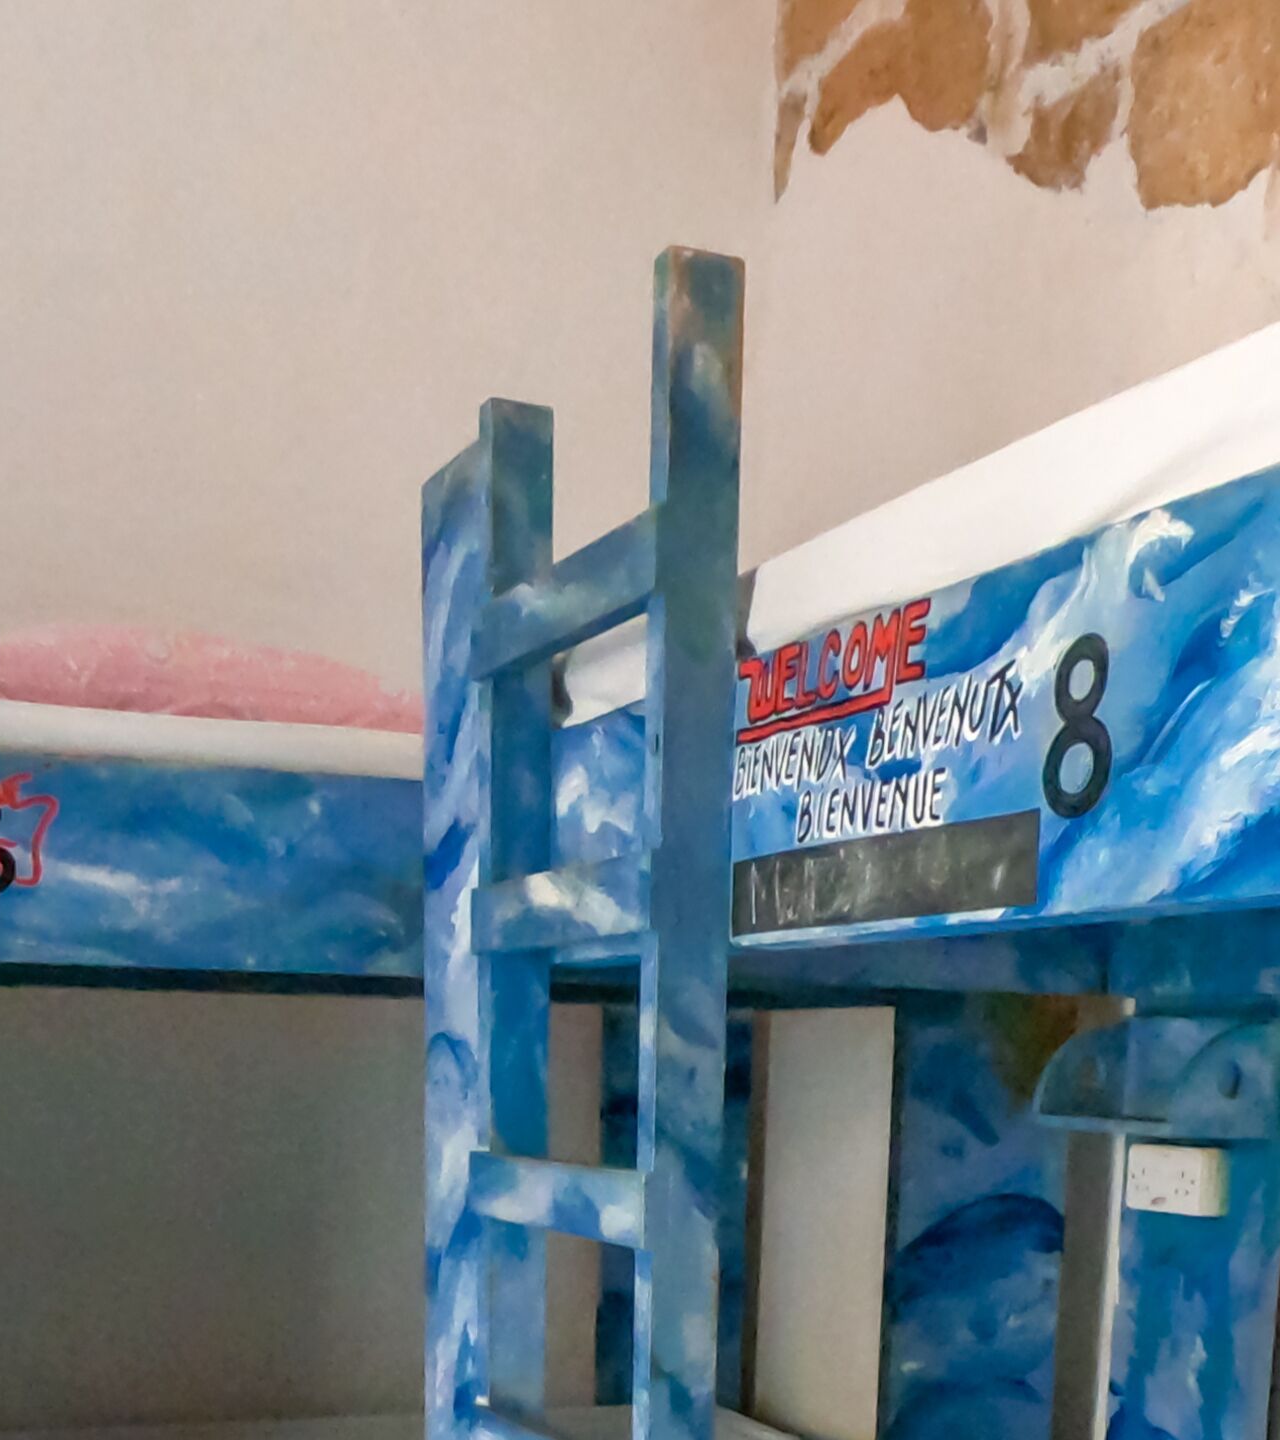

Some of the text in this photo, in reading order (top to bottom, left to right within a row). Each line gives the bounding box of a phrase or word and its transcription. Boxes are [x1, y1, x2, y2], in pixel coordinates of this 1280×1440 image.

[738, 597, 932, 725] WELCOME
[866, 659, 1024, 768] BENVENUTX
[1042, 632, 1113, 819] 8
[794, 766, 948, 844] BIENVENUE
